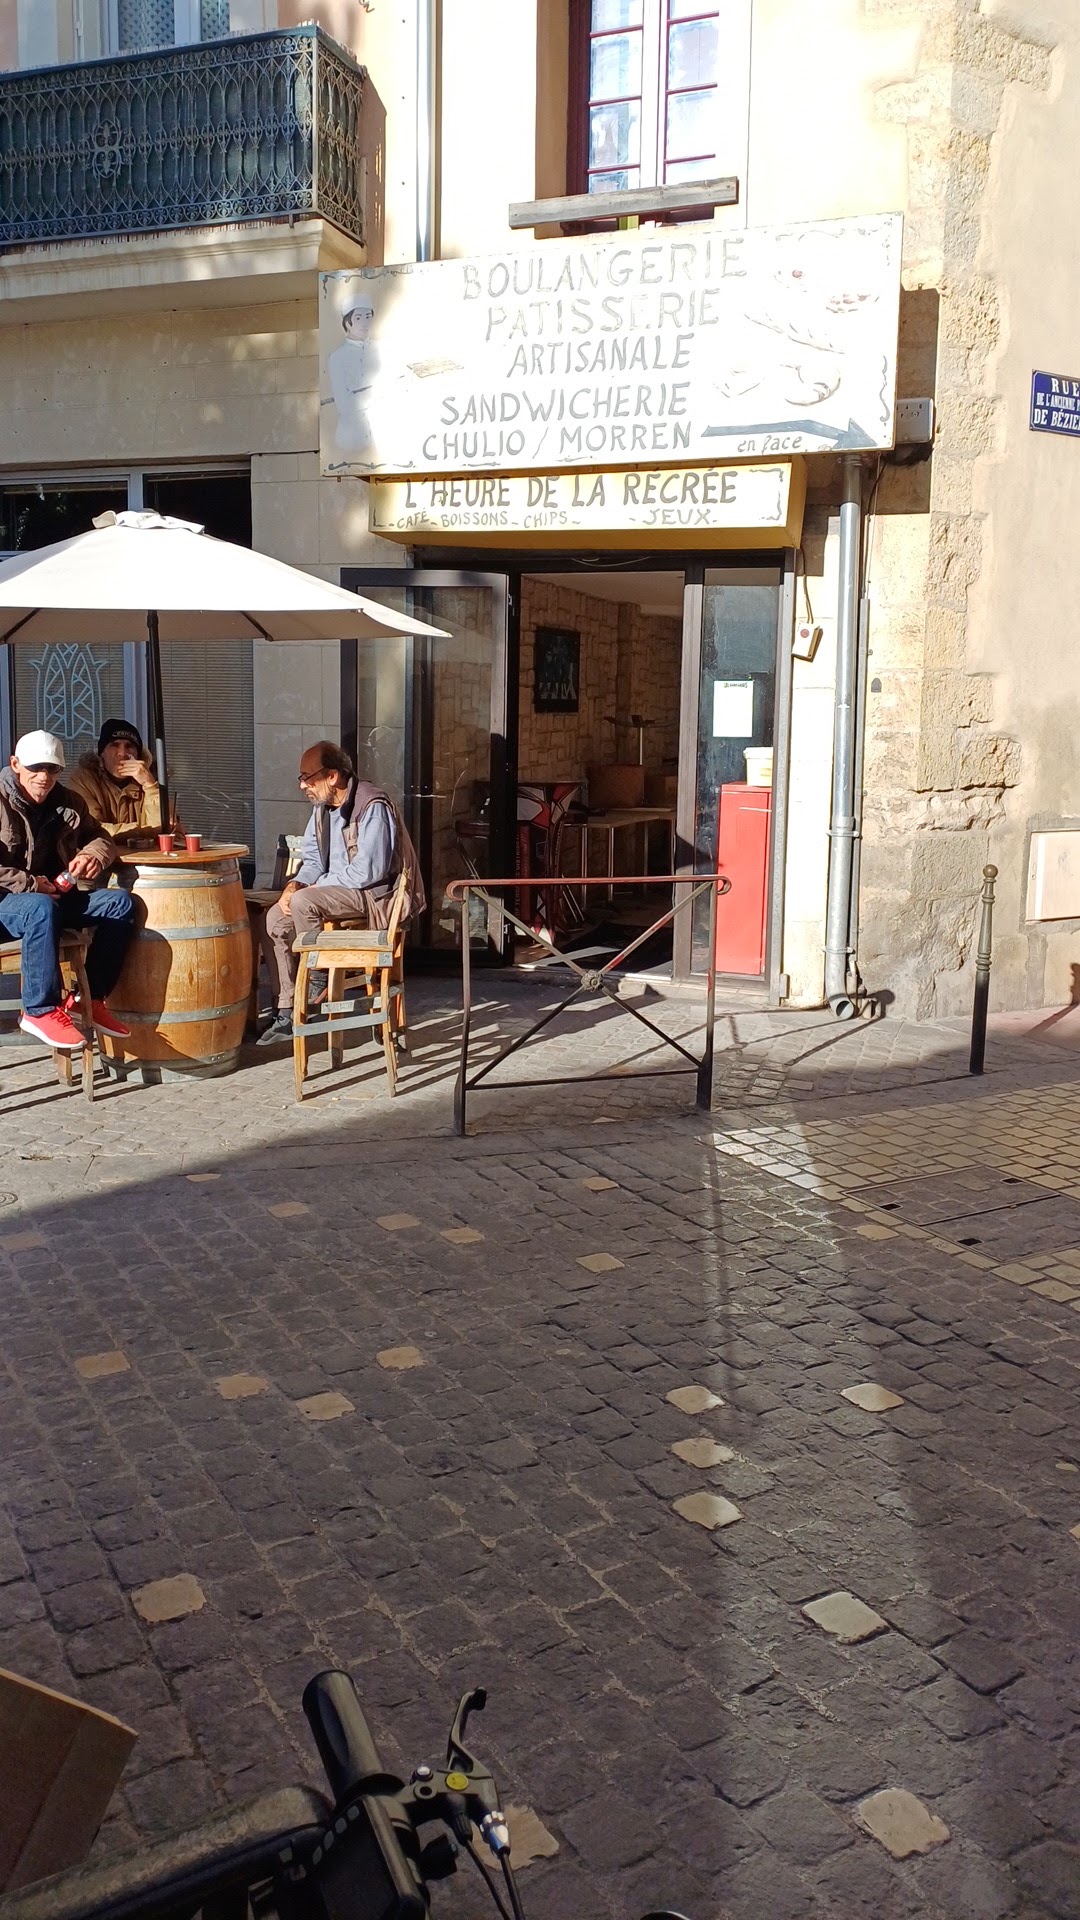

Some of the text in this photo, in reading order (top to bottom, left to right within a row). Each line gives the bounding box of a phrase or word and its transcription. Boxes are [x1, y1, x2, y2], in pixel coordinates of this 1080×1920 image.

[463, 237, 747, 300] BOULANGERIE
[486, 288, 720, 342] PATISSERIE
[506, 333, 694, 378] ARTISANALE
[440, 381, 690, 425] SANDWICHERIE
[1036, 392, 1045, 406] DE
[1051, 378, 1079, 397] RUE
[1034, 408, 1048, 425] DE
[422, 428, 526, 460] CHULIO
[559, 421, 692, 454] MORREN
[737, 434, 803, 456] en face
[404, 476, 511, 509] L'HEURE
[526, 475, 560, 508] DE
[571, 474, 606, 507] LA
[396, 507, 430, 529] CAFÉ
[441, 511, 509, 528] BOISSONS
[523, 510, 568, 529] CHIPS
